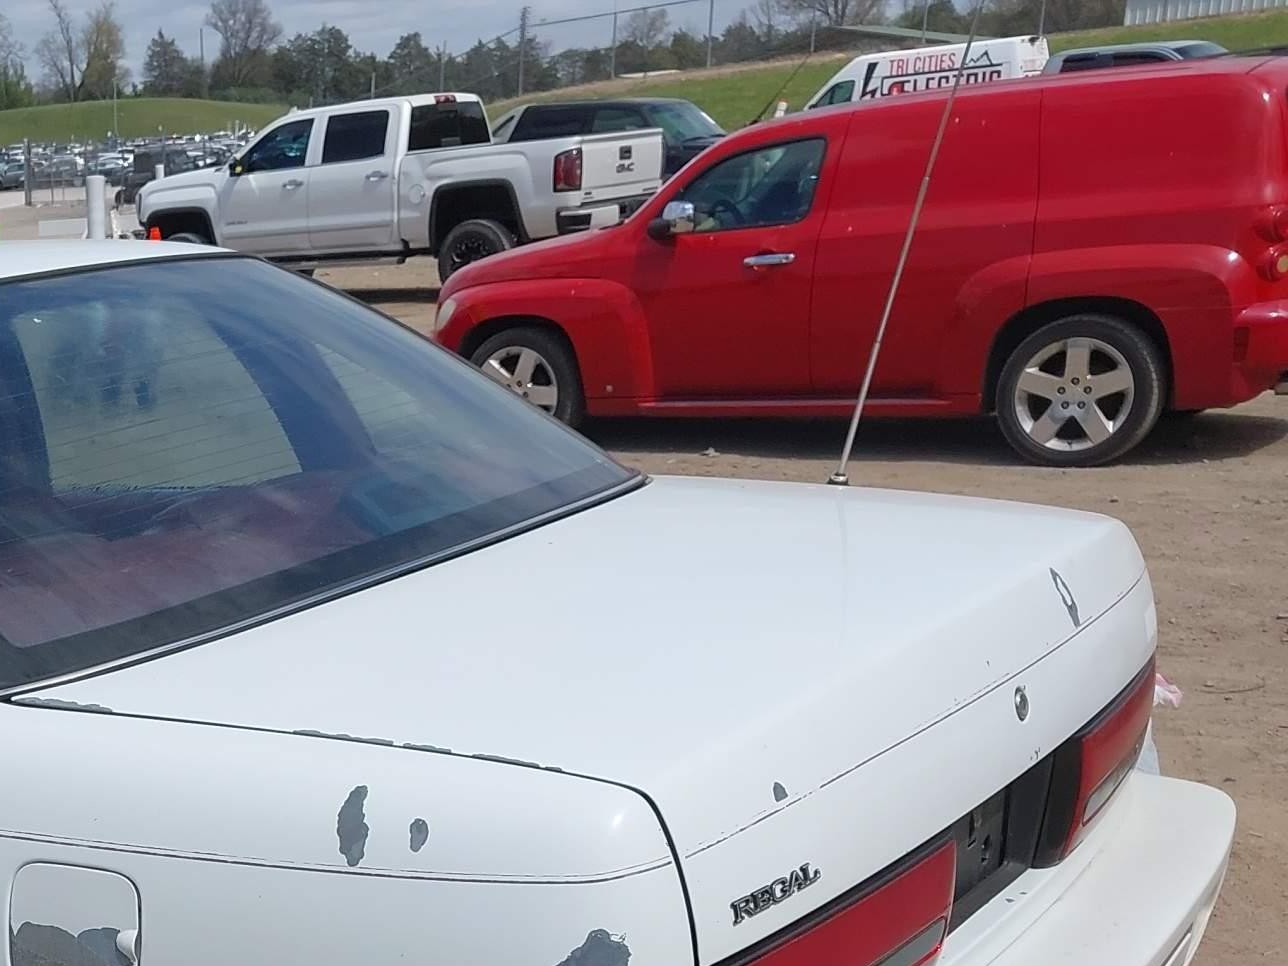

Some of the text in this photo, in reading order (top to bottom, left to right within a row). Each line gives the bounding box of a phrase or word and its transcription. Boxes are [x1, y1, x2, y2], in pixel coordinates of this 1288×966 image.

[890, 53, 956, 76] TRI CITIES
[730, 862, 821, 927] REGAL
